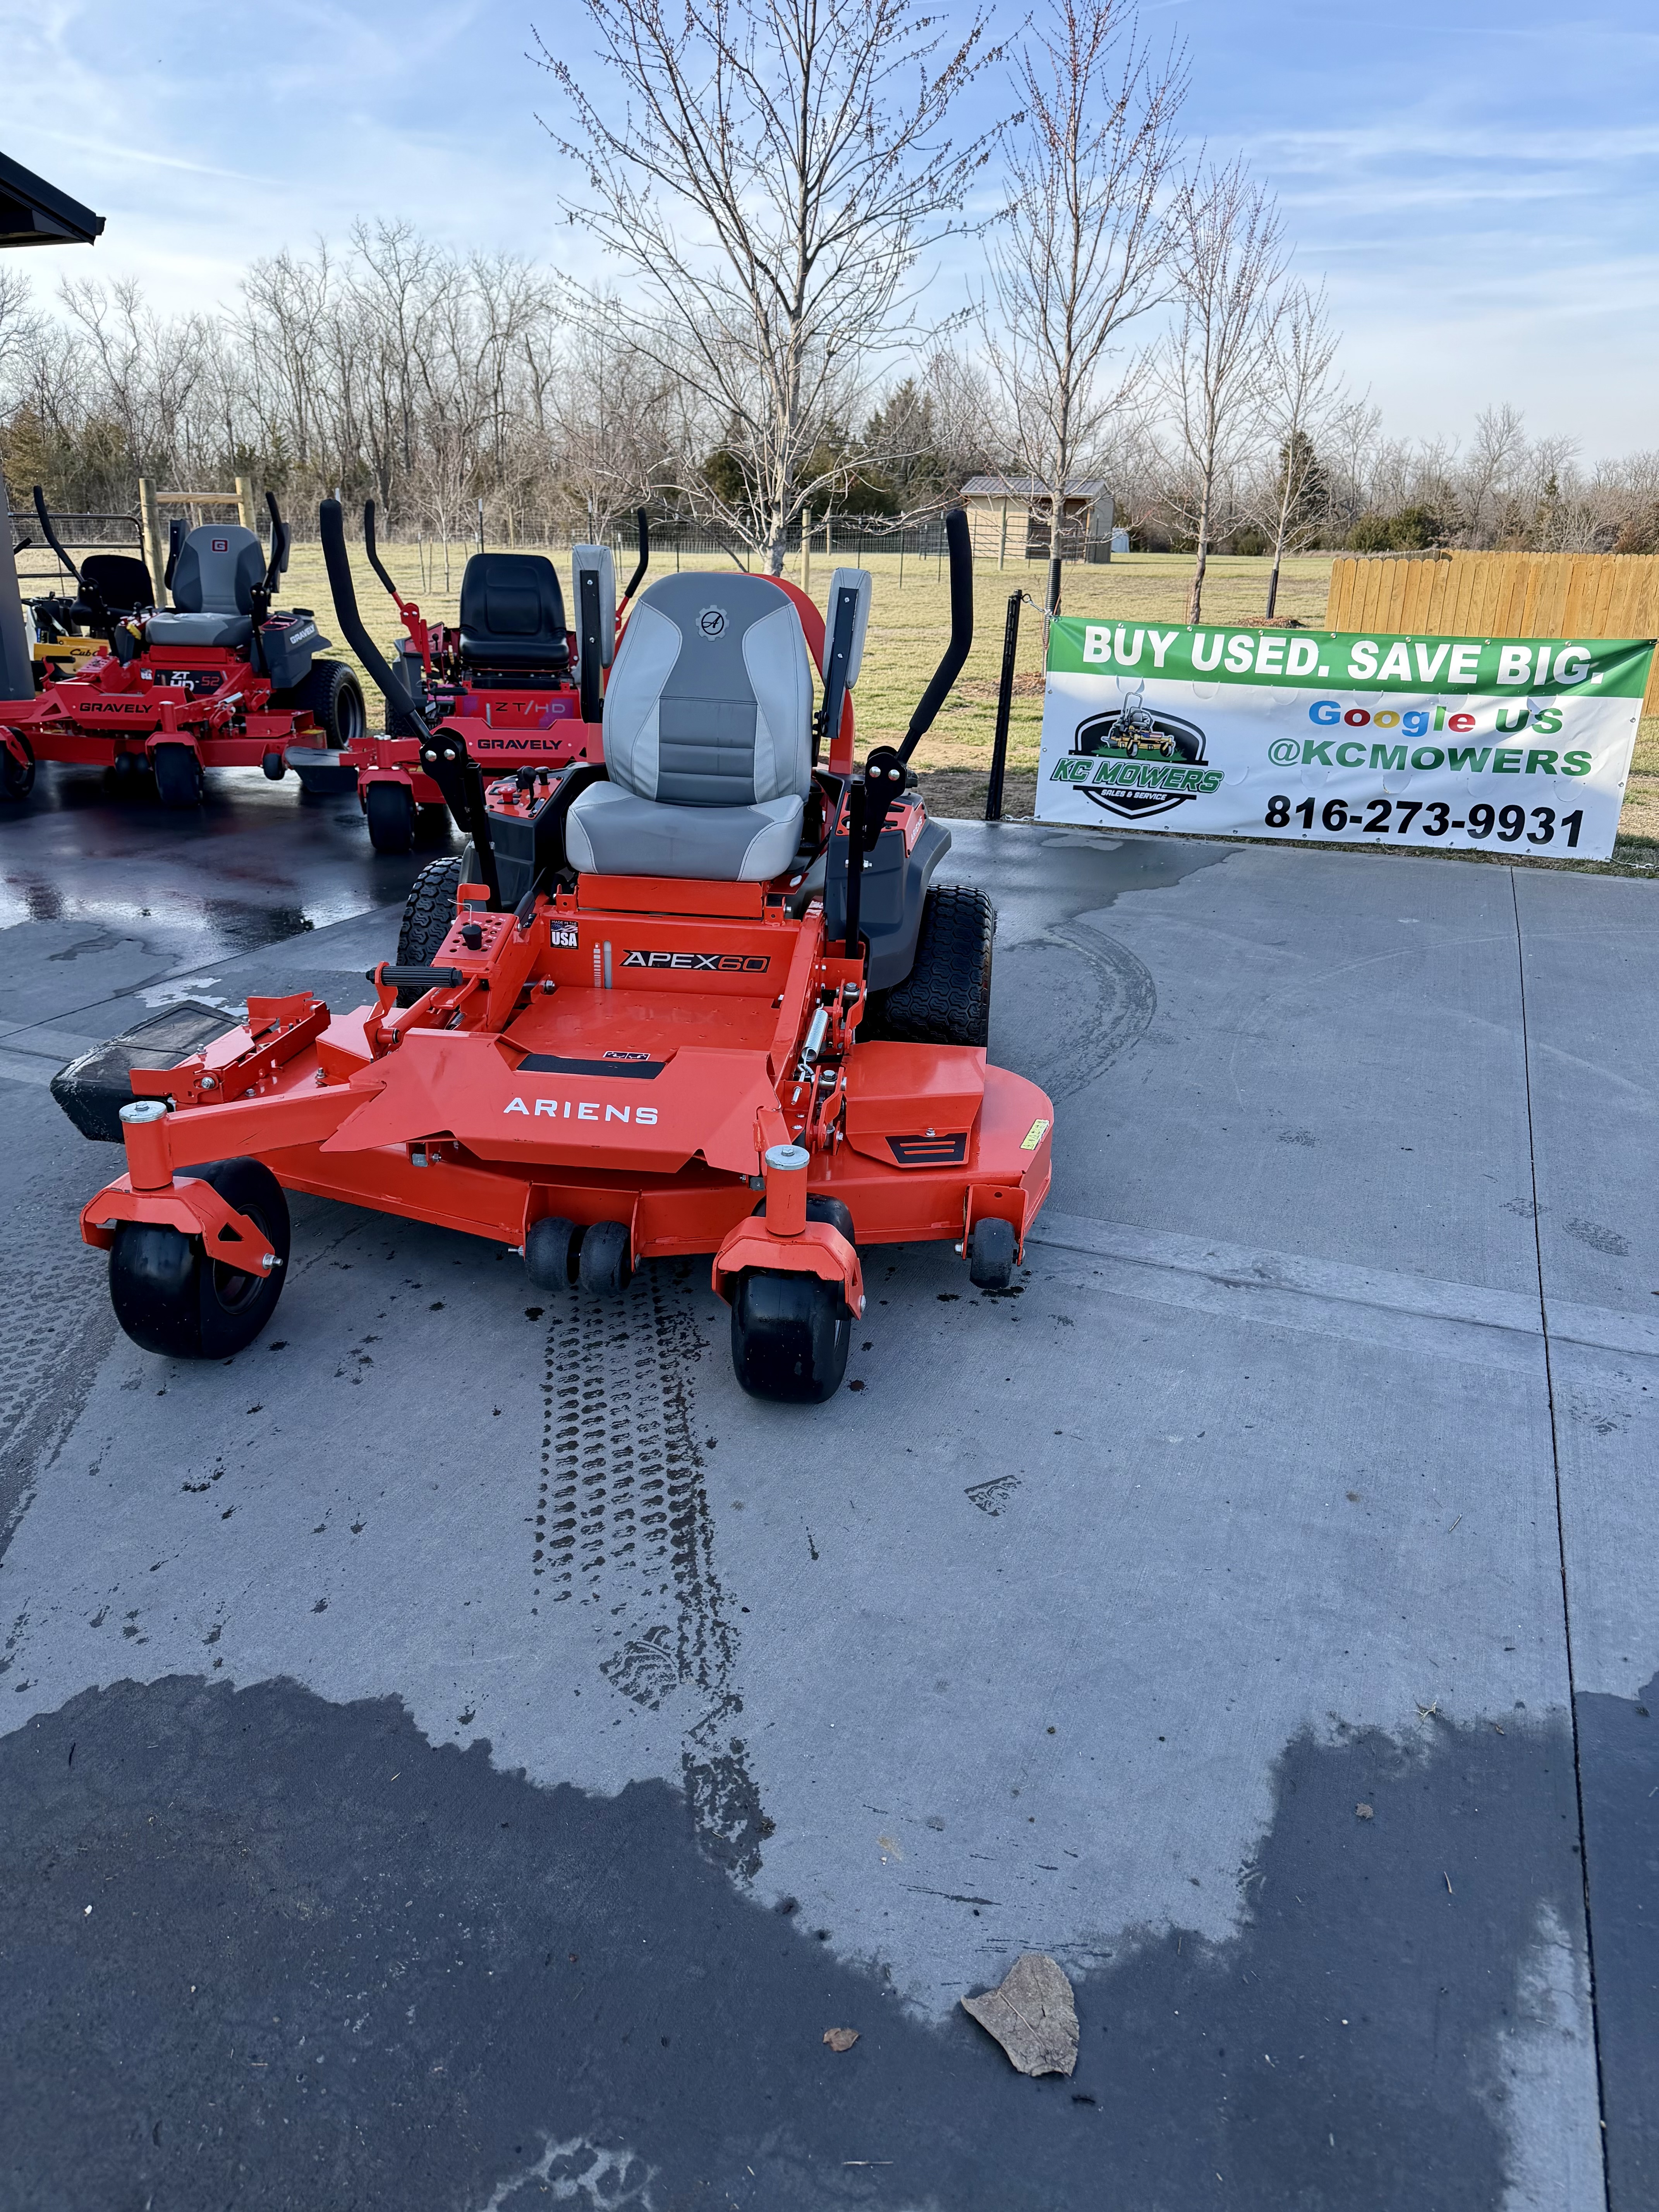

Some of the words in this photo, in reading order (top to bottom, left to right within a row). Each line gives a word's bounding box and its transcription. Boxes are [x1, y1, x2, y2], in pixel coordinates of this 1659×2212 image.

[290, 624, 315, 644] GRAVELY
[1083, 625, 1179, 667] BUY
[1191, 633, 1329, 677] USED.
[1348, 641, 1481, 684] SAVE
[1496, 646, 1604, 685] BIG.
[171, 671, 190, 679] ZT
[80, 702, 153, 713] GRAVELY
[1309, 701, 1476, 737] Google
[1495, 708, 1563, 733] US
[477, 739, 562, 750] GRAVELY
[1267, 738, 1592, 776] @KCMOWERS
[1050, 758, 1093, 781] KC
[1094, 761, 1224, 793] MOWERS
[1133, 792, 1168, 800] SERVICE
[1264, 795, 1584, 848] 816-273-9931
[552, 931, 577, 946] USA
[503, 1097, 658, 1125] ARIENS
